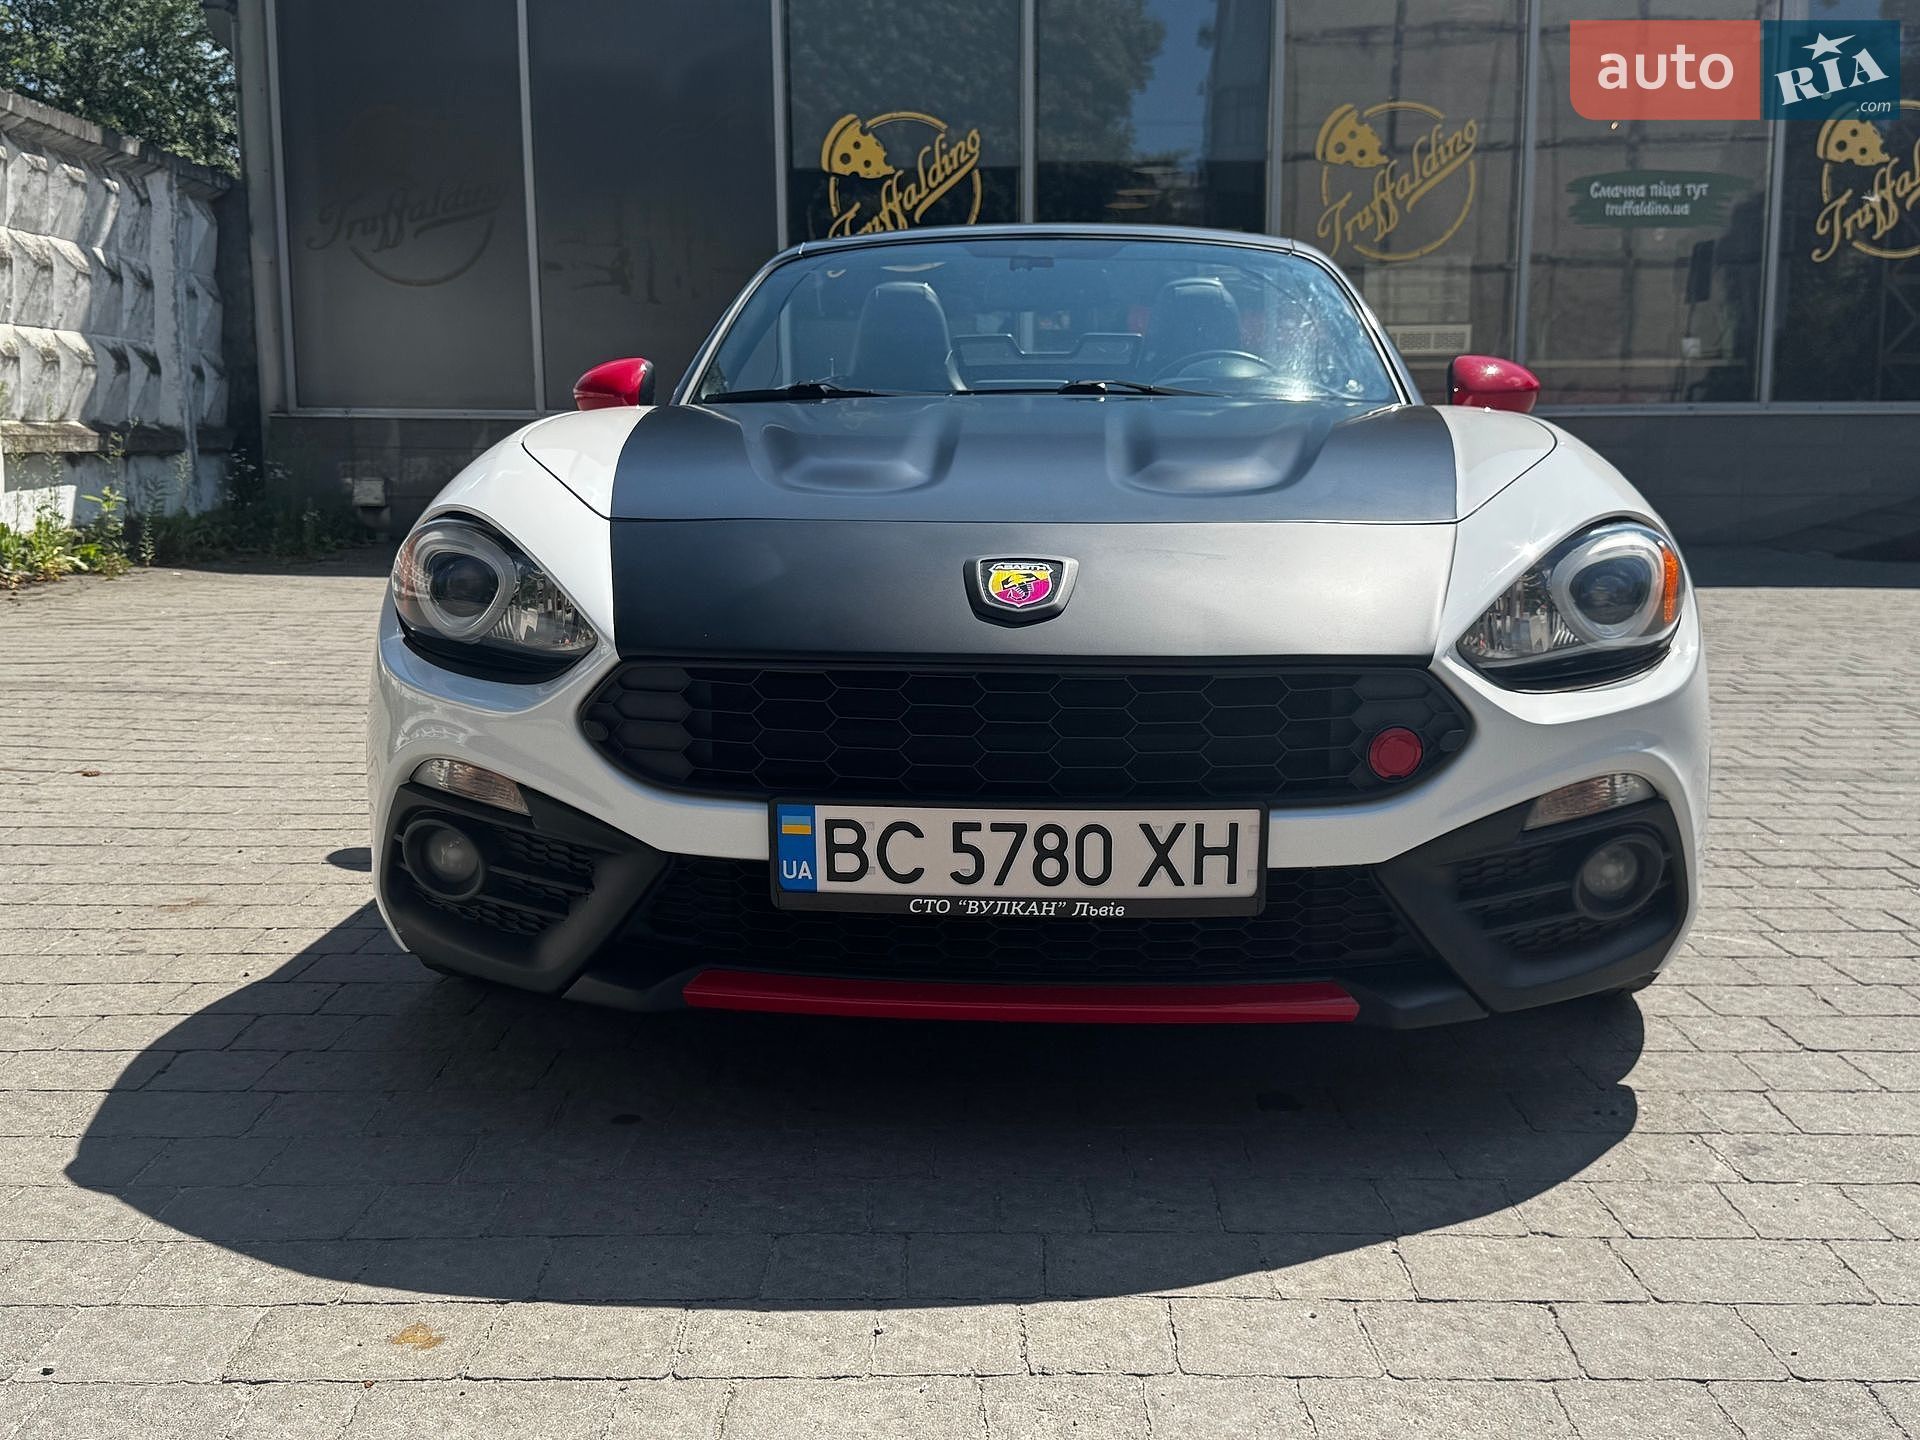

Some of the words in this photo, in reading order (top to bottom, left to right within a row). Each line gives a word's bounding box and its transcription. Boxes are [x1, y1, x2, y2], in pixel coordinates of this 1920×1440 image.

[828, 127, 981, 239] Tuffaldino
[1316, 118, 1478, 257] Truffaldino
[1589, 181, 1646, 199] Смачна
[1650, 180, 1681, 199] піца
[1685, 183, 1709, 200] тут
[1604, 201, 1691, 216] truffaldino.ua
[824, 818, 925, 885] BC
[949, 821, 1113, 887] 5780
[1137, 822, 1240, 888] XH
[782, 860, 813, 880] UA
[909, 898, 951, 914] СТО
[1072, 901, 1126, 918] Львів
